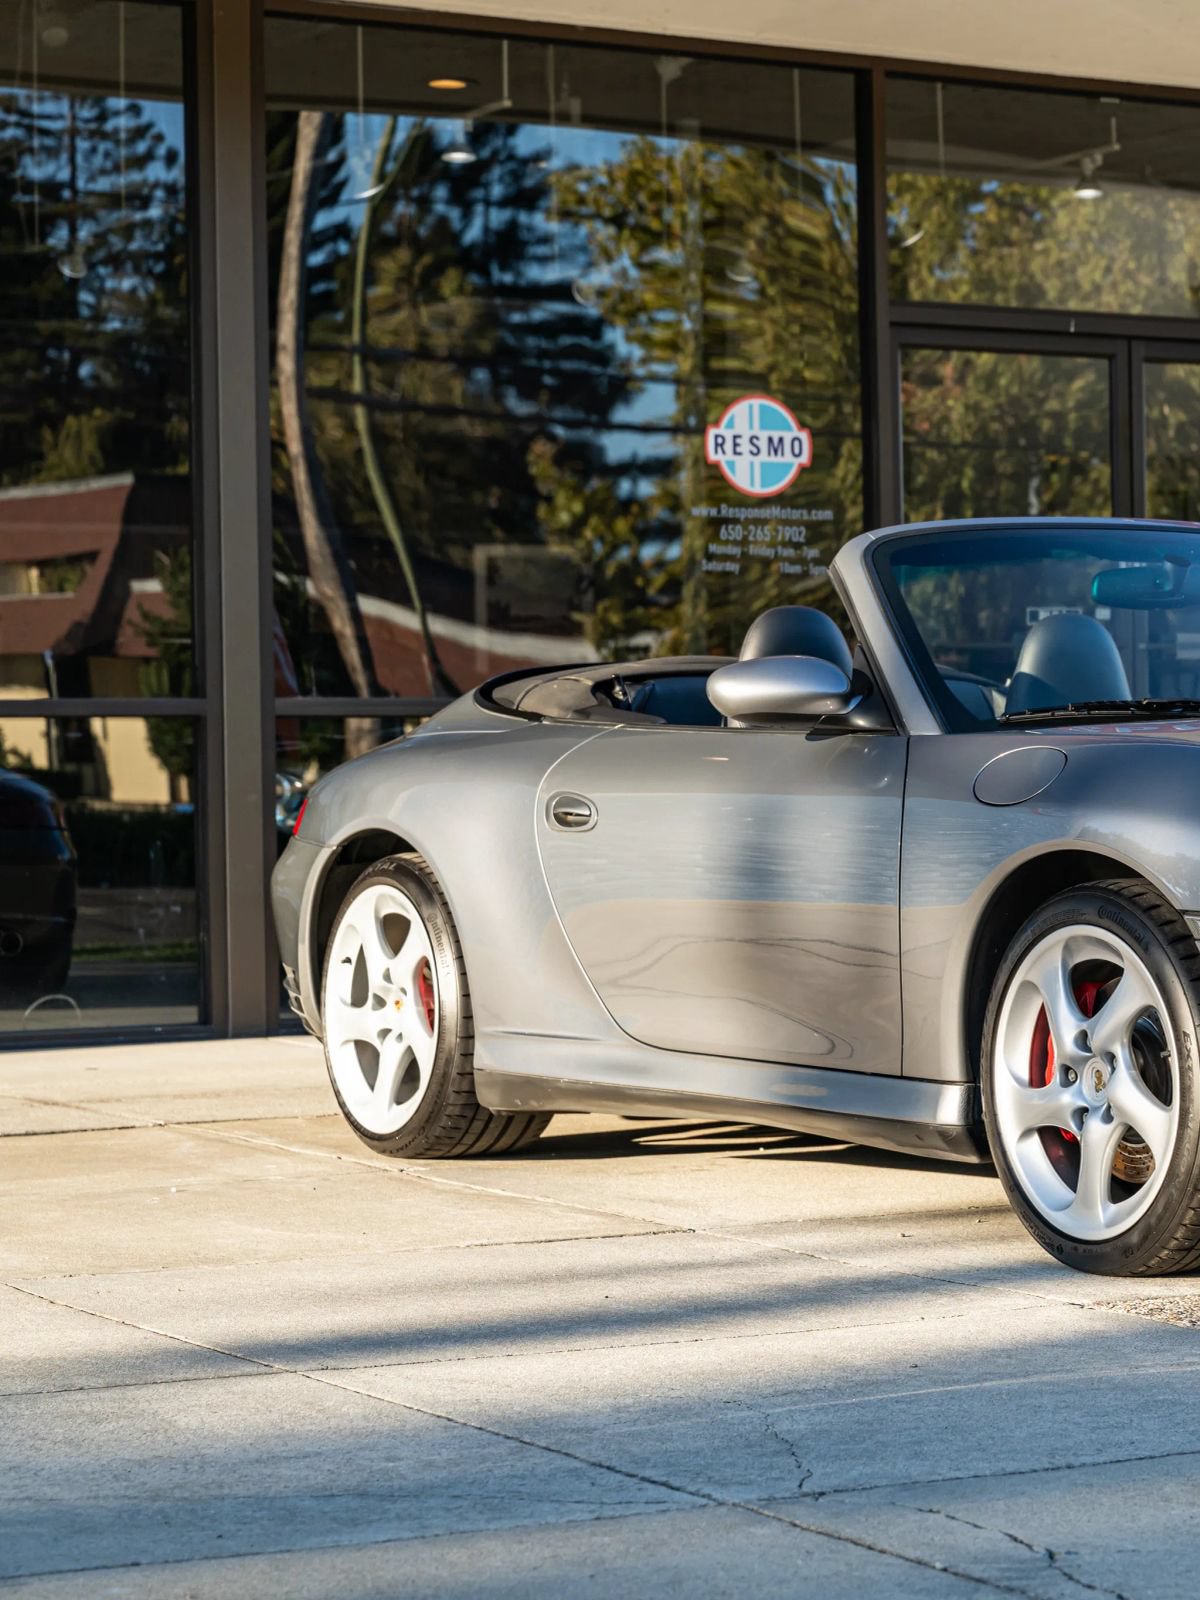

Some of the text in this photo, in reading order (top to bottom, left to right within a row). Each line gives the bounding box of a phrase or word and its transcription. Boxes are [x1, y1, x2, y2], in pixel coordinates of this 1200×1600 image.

[714, 434, 803, 458] RESMO
[691, 503, 833, 521] www.ResponseMotors.com
[720, 524, 807, 543] 650-265-7902
[708, 544, 742, 559] Monday
[749, 544, 776, 559] Friday
[702, 559, 740, 575] Saturday
